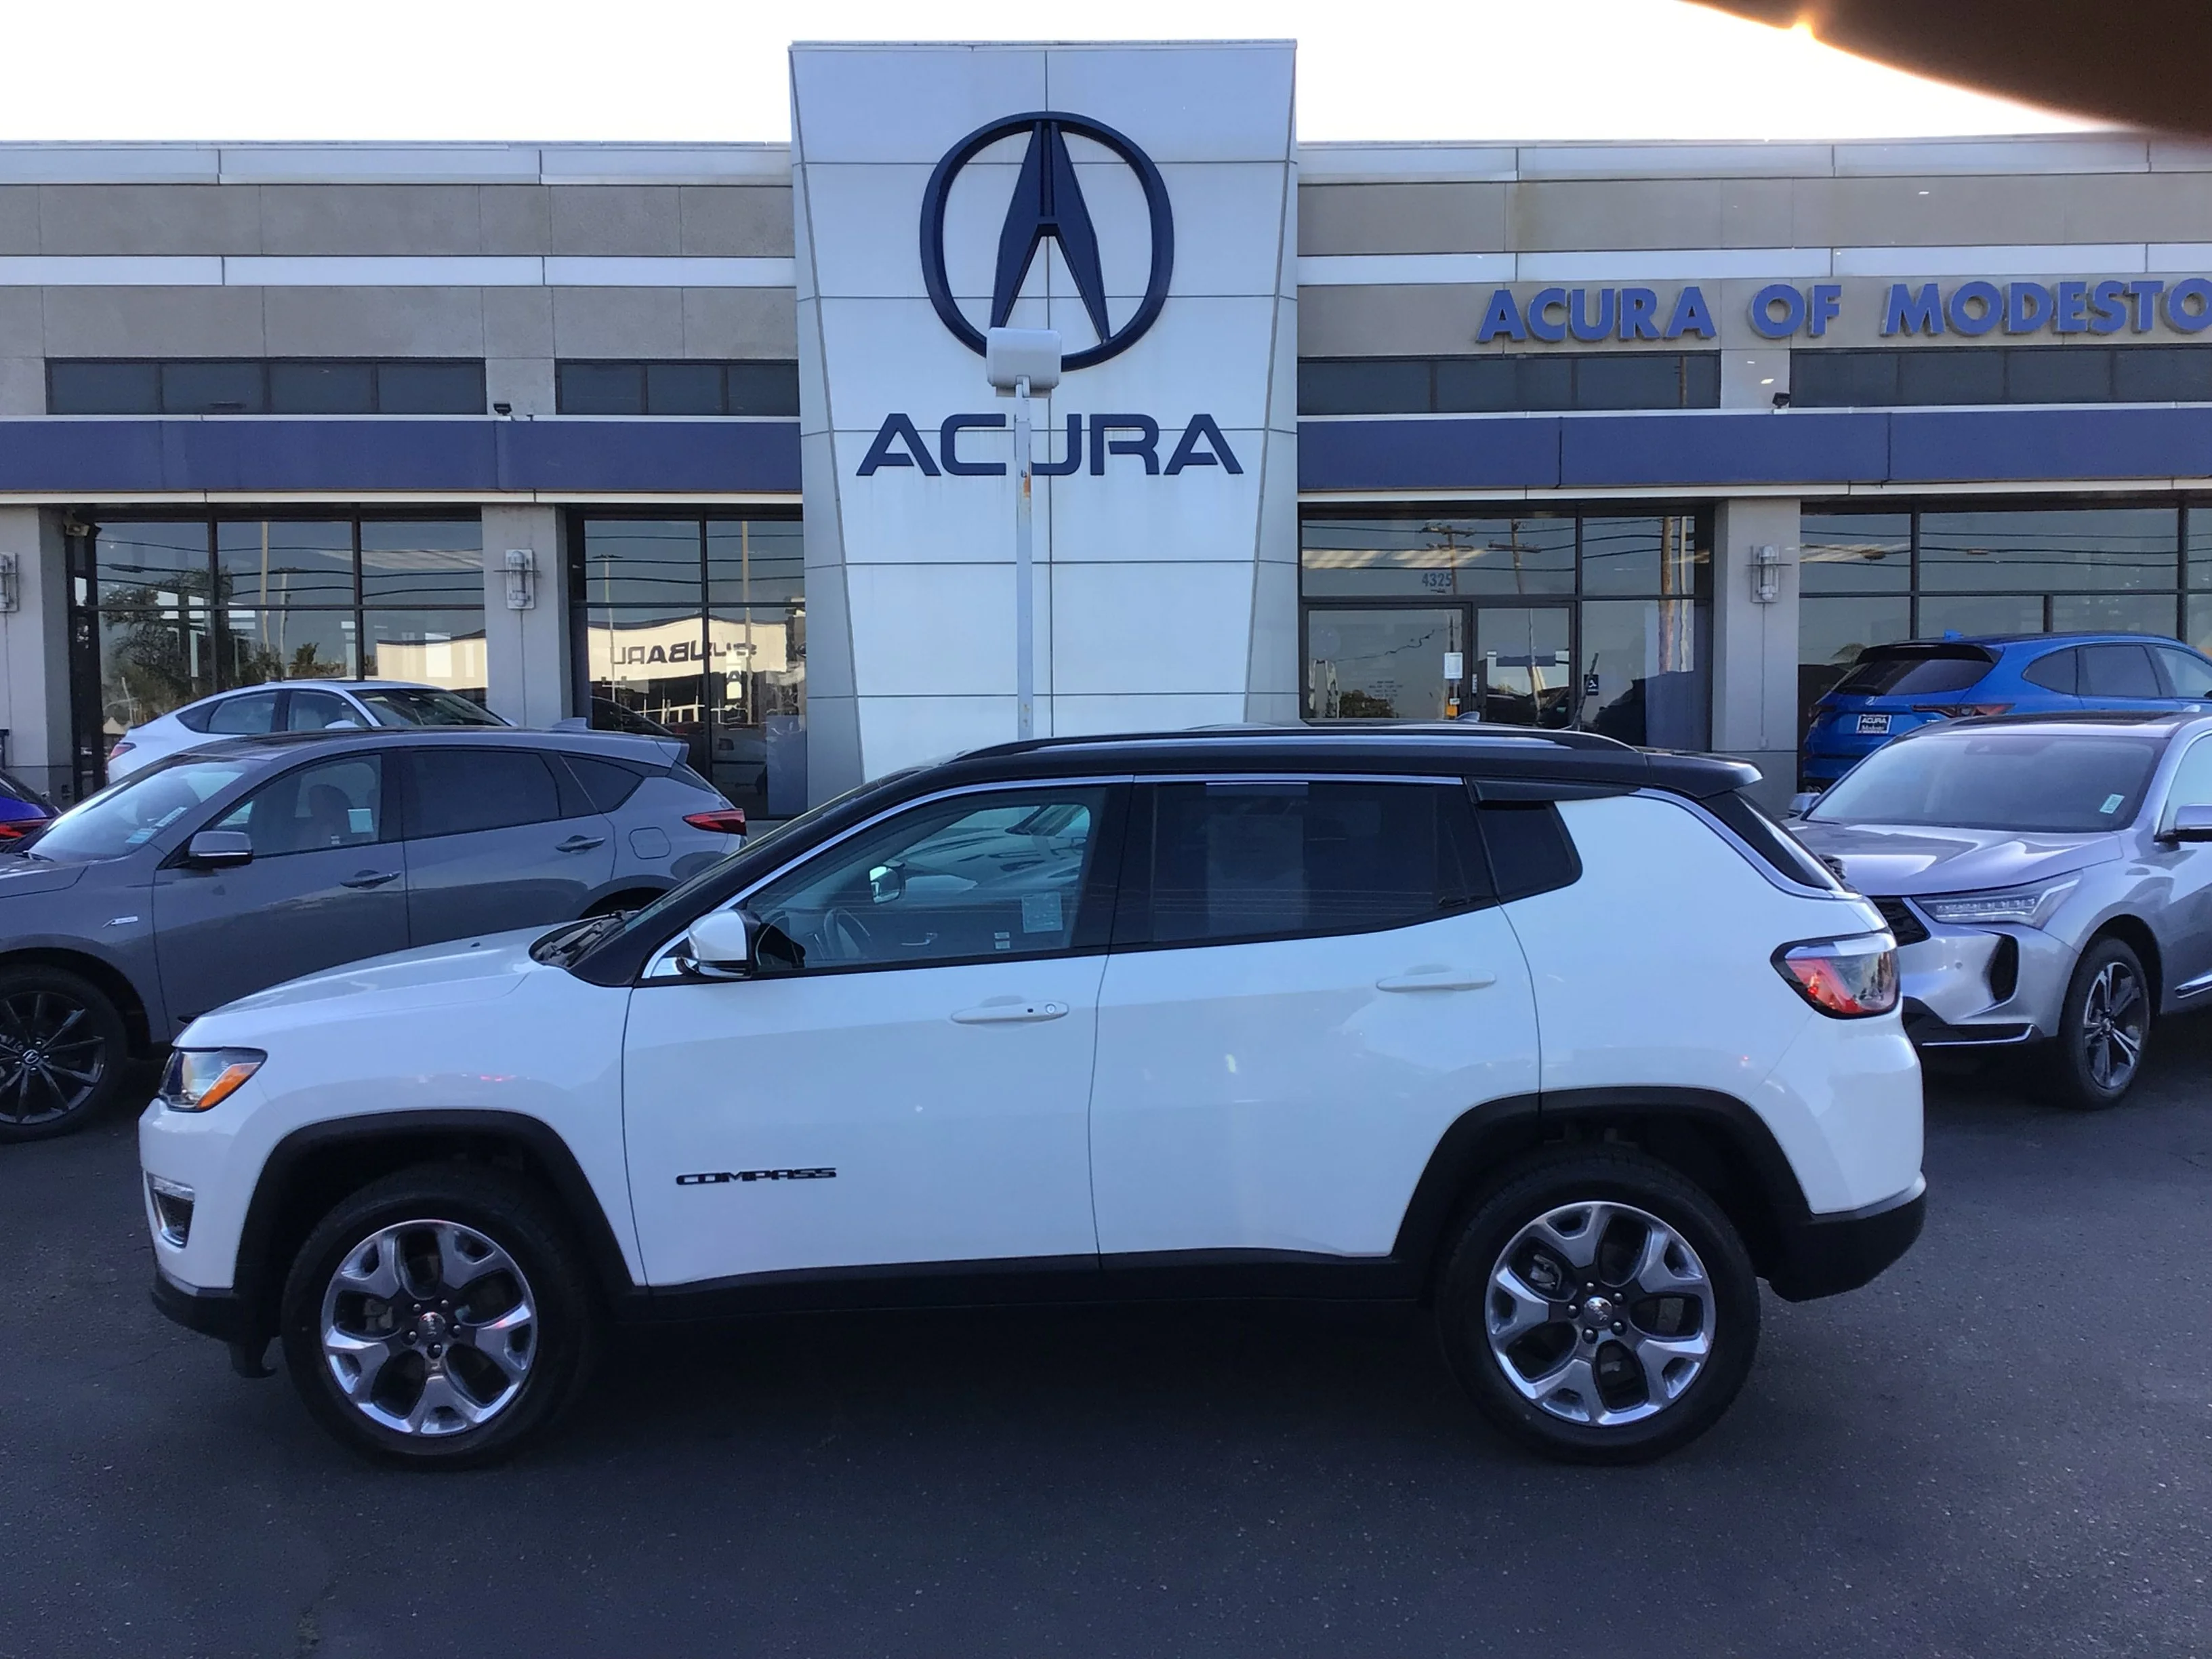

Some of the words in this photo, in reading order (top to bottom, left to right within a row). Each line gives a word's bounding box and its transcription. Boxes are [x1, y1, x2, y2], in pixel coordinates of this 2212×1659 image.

[1476, 286, 1717, 343] ACURA
[1747, 283, 1842, 338] OF
[1879, 278, 2212, 337] MODESTO
[856, 413, 1243, 476] ACURA
[1422, 573, 1452, 587] 4325
[676, 1168, 836, 1185] COMPASS
